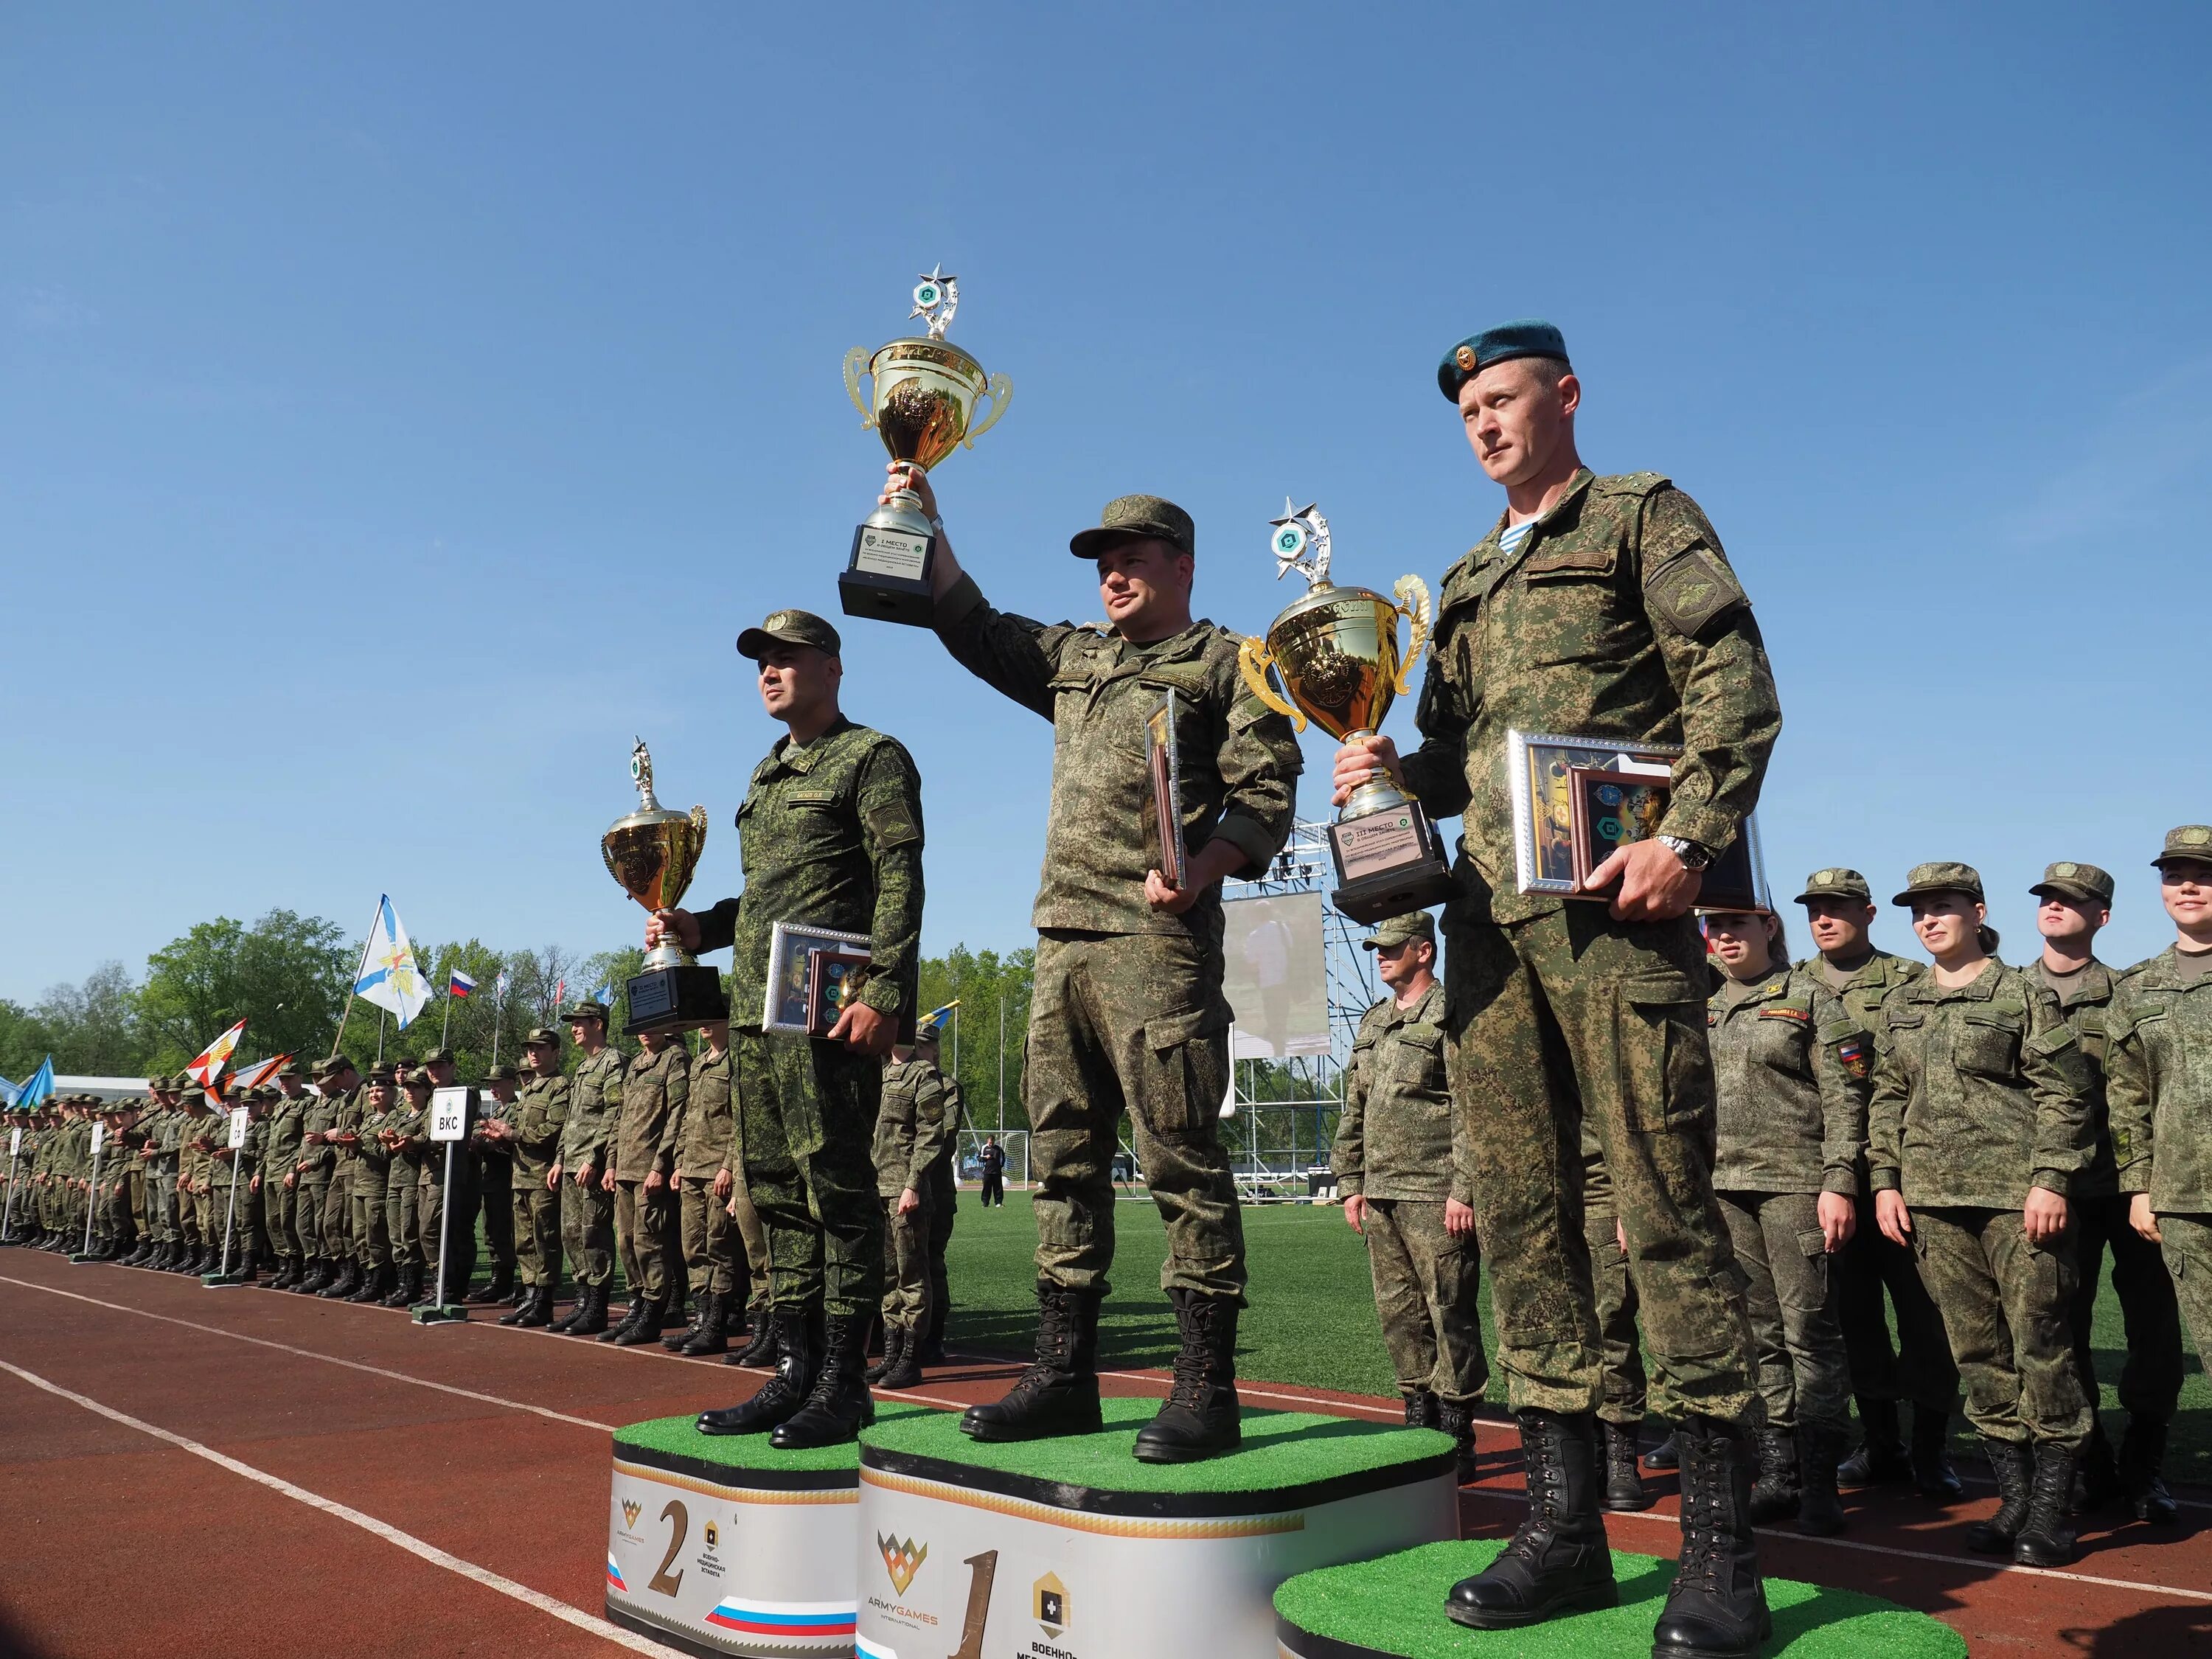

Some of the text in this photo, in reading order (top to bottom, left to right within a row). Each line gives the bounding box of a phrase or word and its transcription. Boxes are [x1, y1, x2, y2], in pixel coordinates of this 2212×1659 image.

[886, 540, 908, 548] МЕСТО
[1662, 568, 1694, 594] РОССИЯ
[1368, 821, 1394, 835] МЕСТО
[439, 1116, 458, 1130] ВКС
[234, 1130, 241, 1140] СФ
[647, 1499, 689, 1599] 2
[702, 1553, 720, 1562] ВОЕННО-
[697, 1558, 726, 1573] МЕДИЦИНСКАЯ
[700, 1567, 720, 1579] ЭСТАФЕТА
[868, 1595, 938, 1626] ARMYGAMES
[947, 1549, 999, 1659] 1
[880, 1613, 920, 1631] INTERNATIONAL
